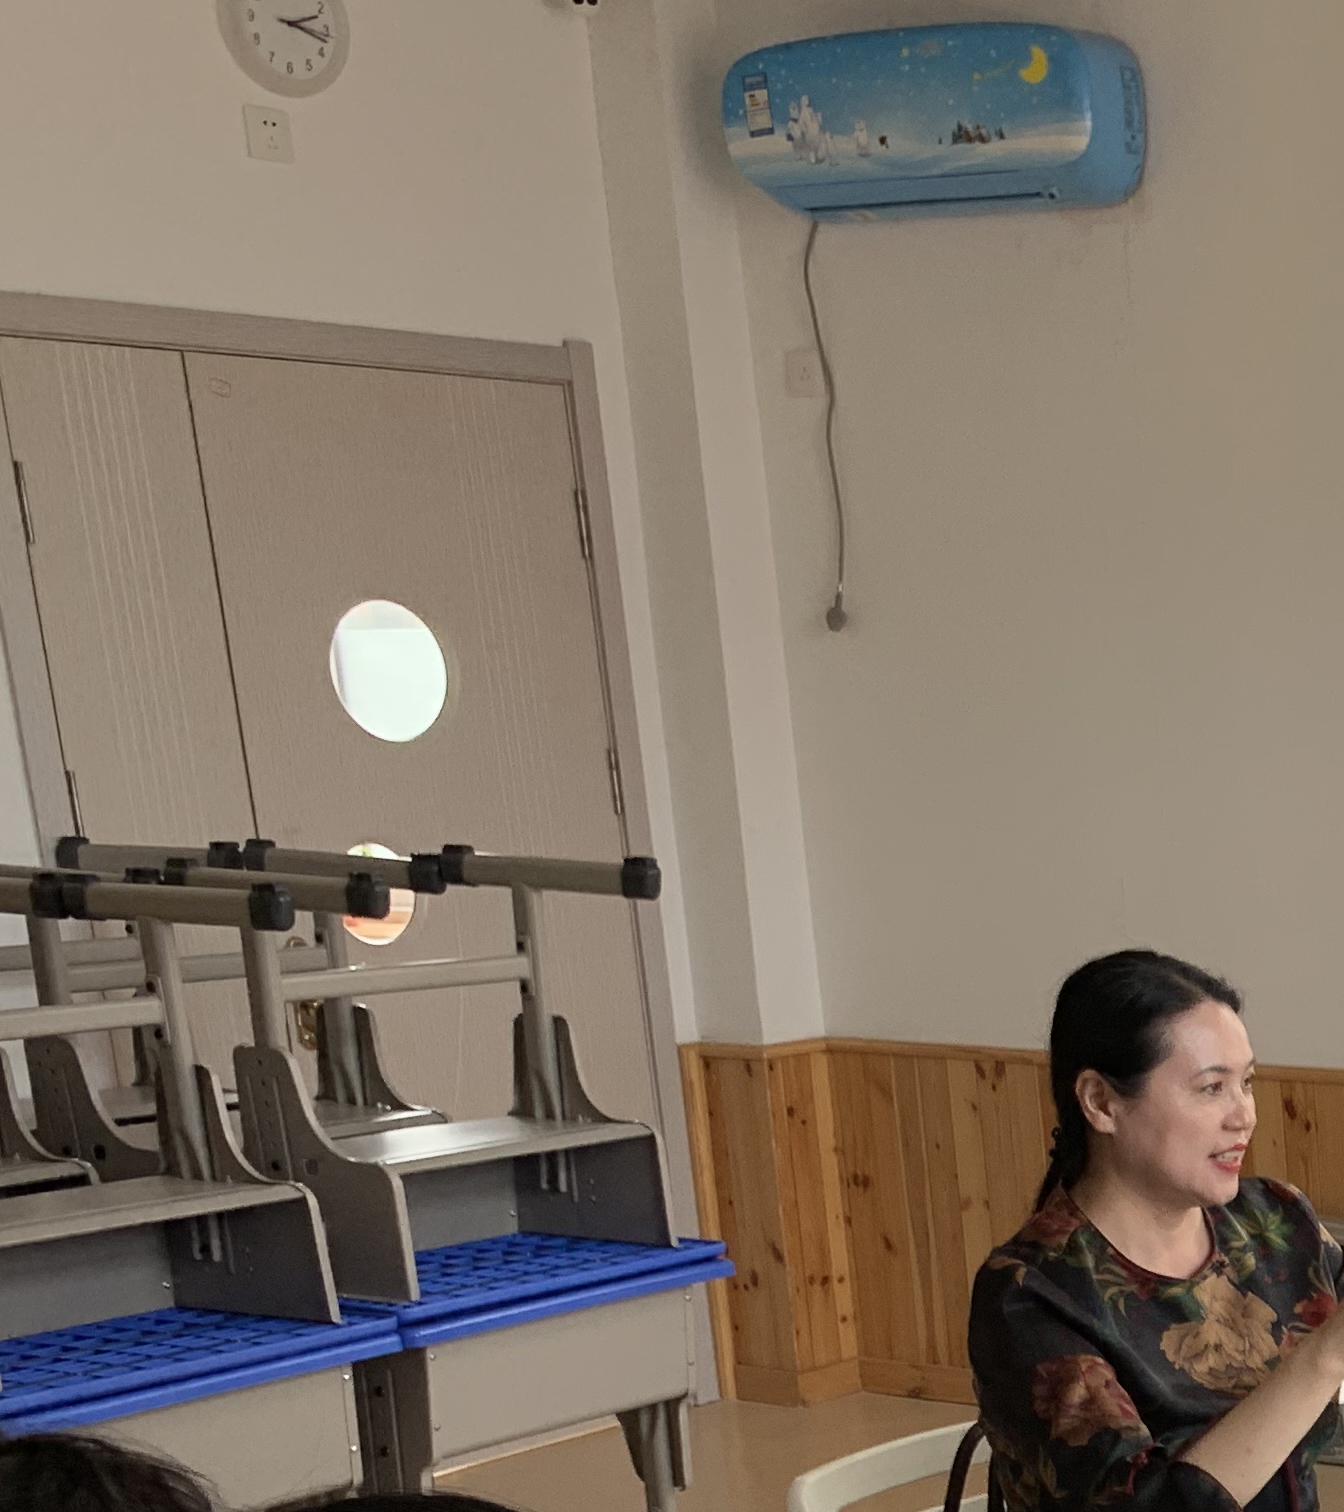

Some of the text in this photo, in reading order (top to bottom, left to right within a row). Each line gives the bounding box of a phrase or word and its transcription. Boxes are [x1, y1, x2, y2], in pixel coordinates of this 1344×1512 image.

[317, 1, 324, 14] 2
[269, 51, 275, 63] 7
[318, 46, 325, 58] 4
[286, 61, 294, 74] 6
[305, 59, 313, 71] 5
